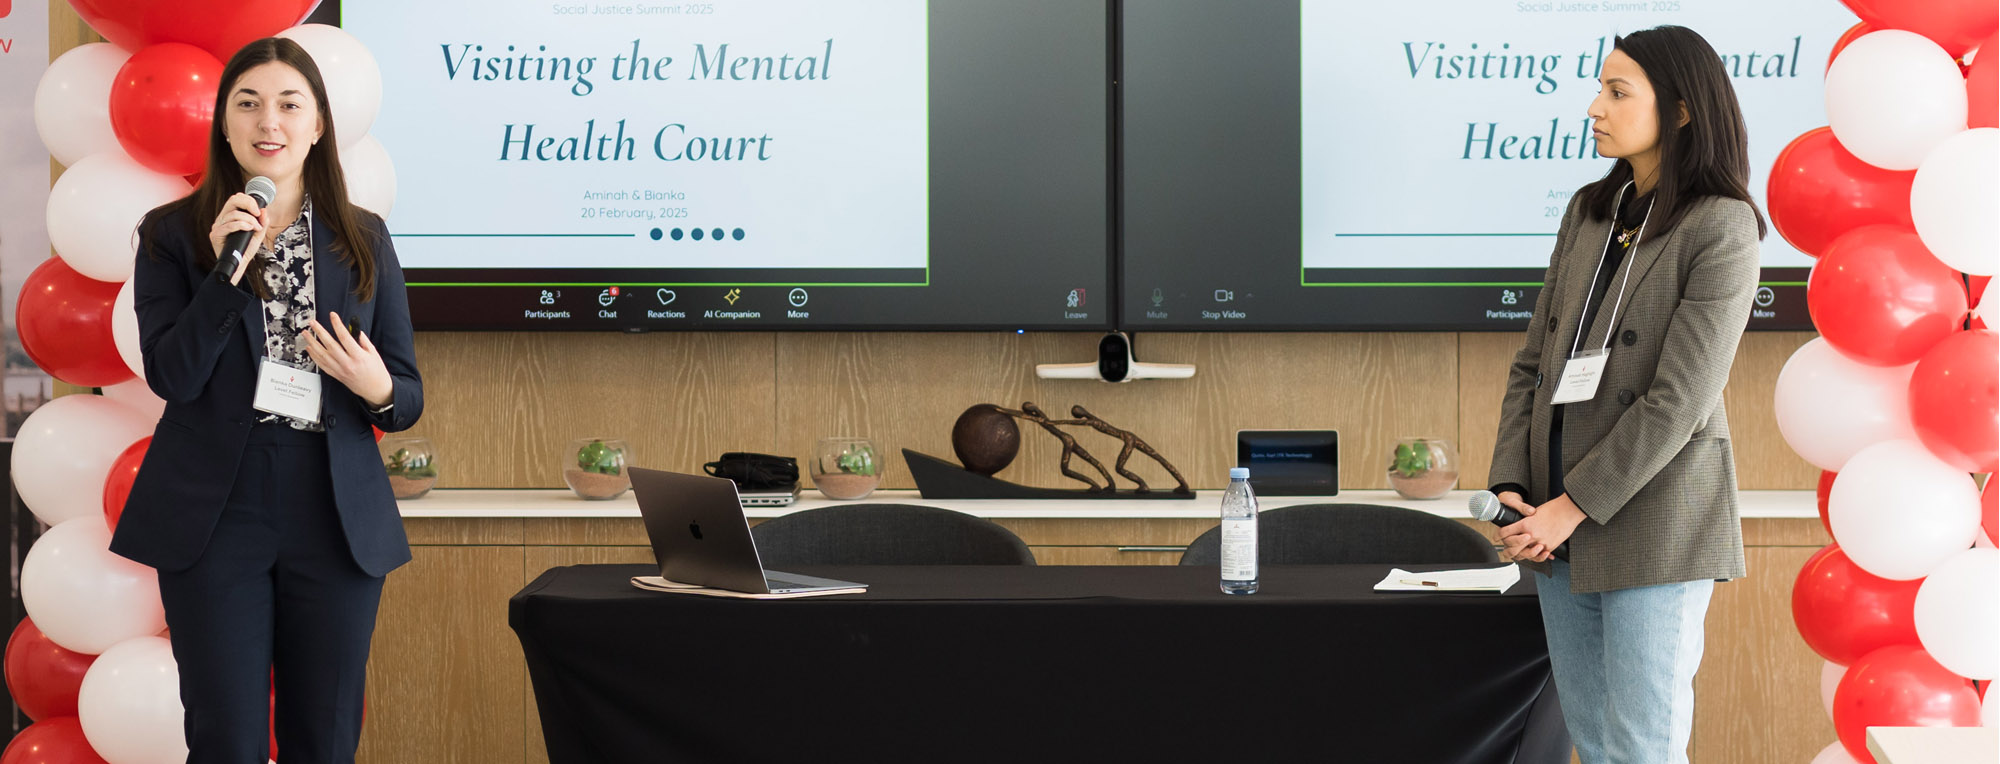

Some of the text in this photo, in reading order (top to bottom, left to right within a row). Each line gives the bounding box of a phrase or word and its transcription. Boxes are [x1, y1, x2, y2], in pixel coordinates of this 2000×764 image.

[552, 3, 714, 15] Social Justice Summit 2025
[1516, 0, 1681, 13] Social Justice Summit 2025
[440, 38, 834, 97] Visiting the Mental
[1402, 41, 1562, 95] Visiting
[498, 118, 774, 162] Health Court
[1461, 116, 1598, 160] Health
[583, 189, 685, 201] Aminah & Bianka
[580, 207, 688, 221] 20 February, 2025
[1544, 206, 1560, 218] 20
[524, 309, 571, 320] Participants
[598, 309, 618, 319] Chat
[647, 309, 686, 319] Reactions
[704, 309, 761, 320] AI Companion
[787, 309, 810, 319] More
[1064, 310, 1088, 319] Leave
[1146, 310, 1169, 319] Mute
[1201, 310, 1247, 321] Stop Video
[1486, 309, 1533, 320] Participants
[1753, 309, 1776, 318] More
